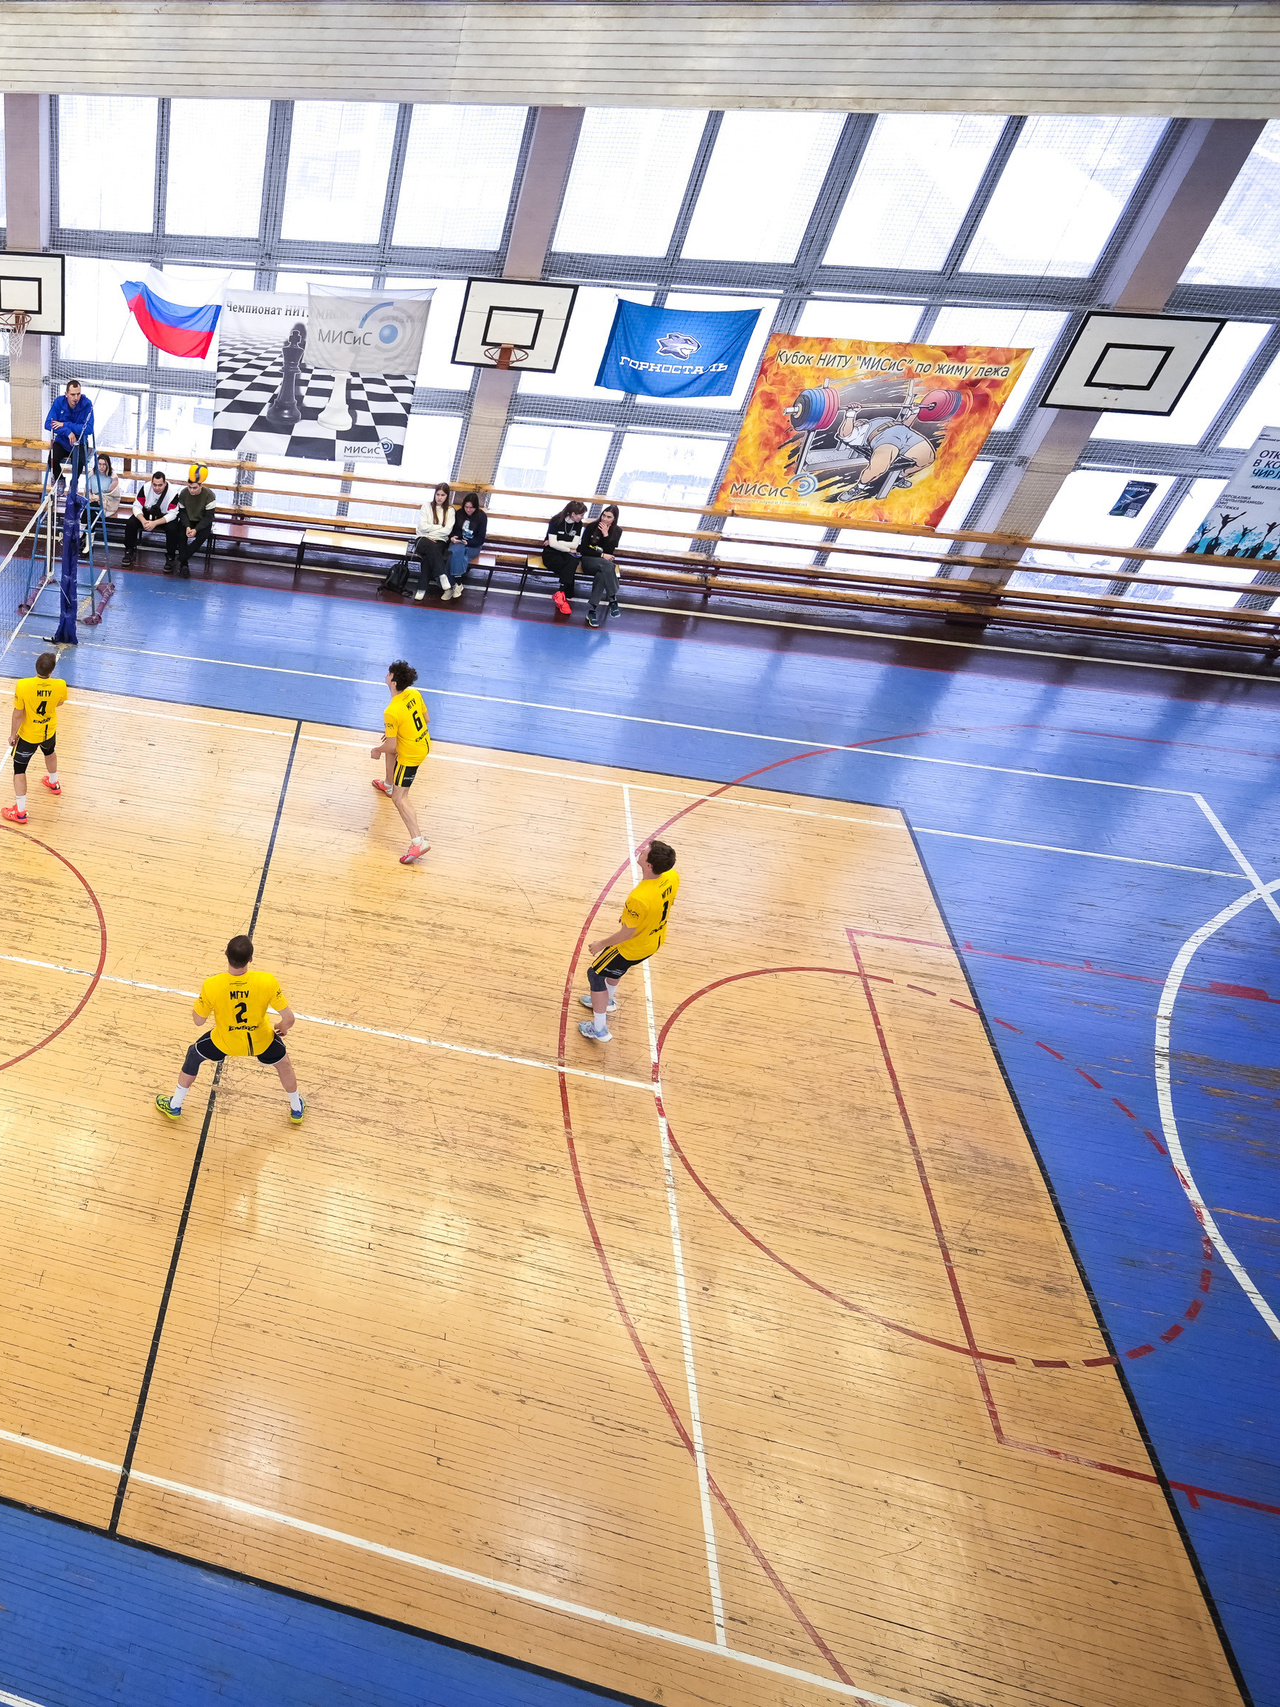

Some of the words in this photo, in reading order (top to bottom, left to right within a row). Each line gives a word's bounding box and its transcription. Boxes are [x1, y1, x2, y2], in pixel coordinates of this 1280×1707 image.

[226, 301, 283, 316] Чемпионат
[317, 328, 373, 346] МИСиС
[619, 356, 728, 375] ГОРНОСТАЛЬ
[775, 350, 812, 366] Кубок
[816, 353, 853, 369] НИТУ
[915, 363, 932, 373] по
[934, 365, 973, 379] жиму
[975, 366, 1011, 378] лежа
[343, 445, 381, 455] МИСиС
[1252, 458, 1262, 467] В
[729, 483, 792, 498] МИСиС
[36, 701, 48, 716] 4
[412, 710, 423, 731] 6
[661, 900, 669, 922] 1
[229, 990, 250, 1000] МГТУ
[234, 1002, 248, 1024] 2
